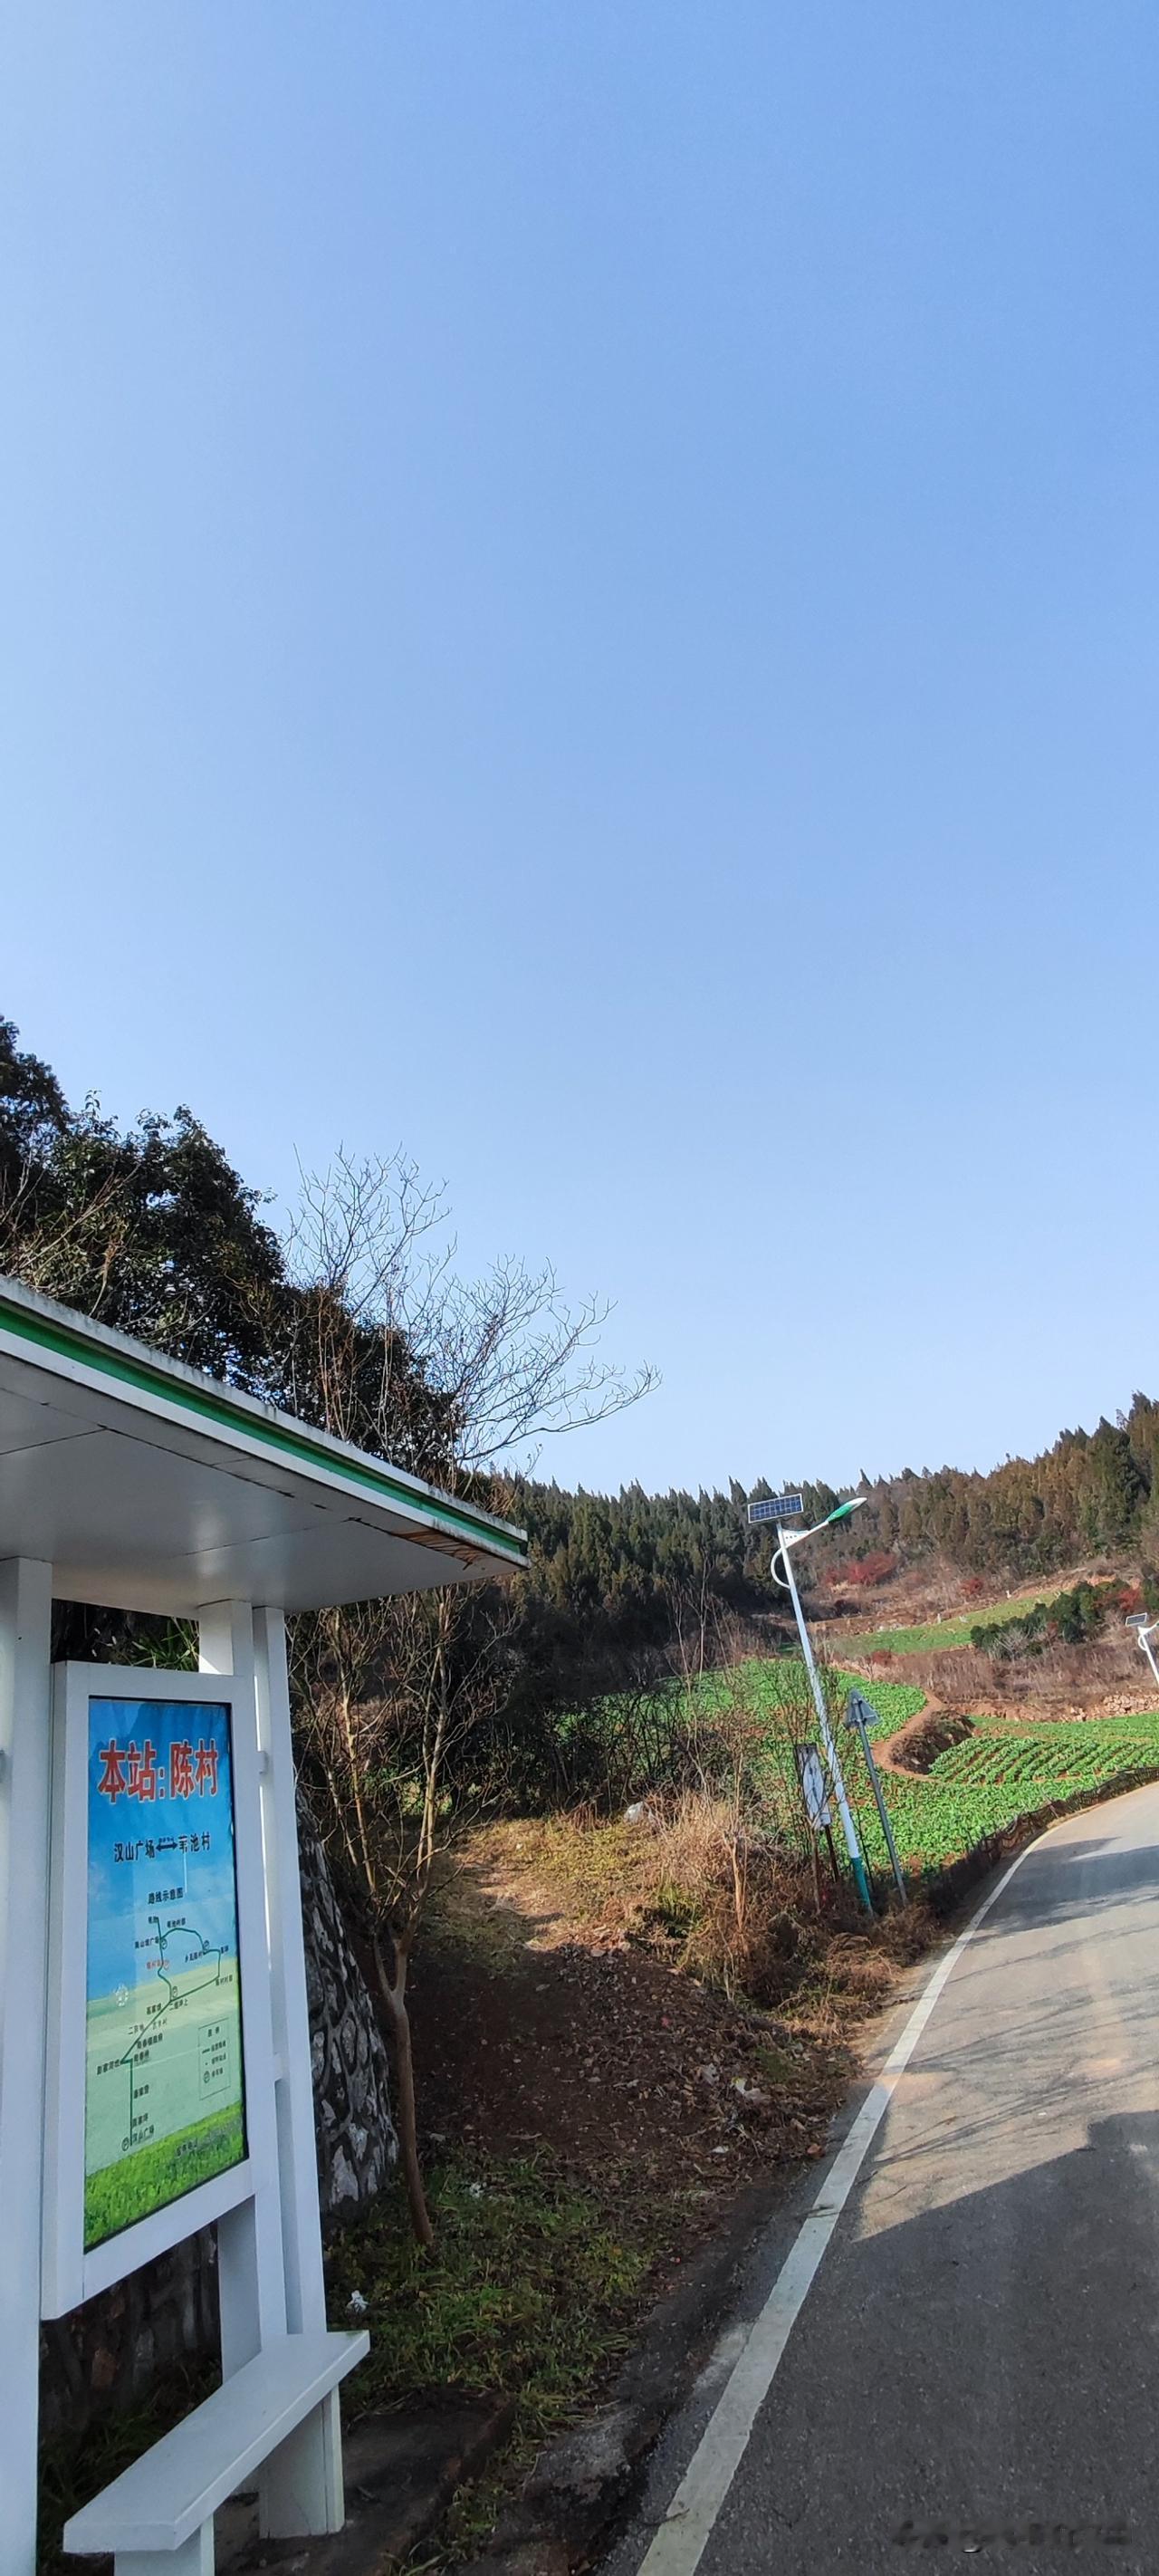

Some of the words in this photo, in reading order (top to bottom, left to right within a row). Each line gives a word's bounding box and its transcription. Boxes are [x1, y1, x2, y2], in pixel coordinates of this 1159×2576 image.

[99, 1738, 218, 1803] 本站:陈村
[114, 1840, 155, 1862] 汉山广场
[148, 1888, 184, 1905] 路线示意图
